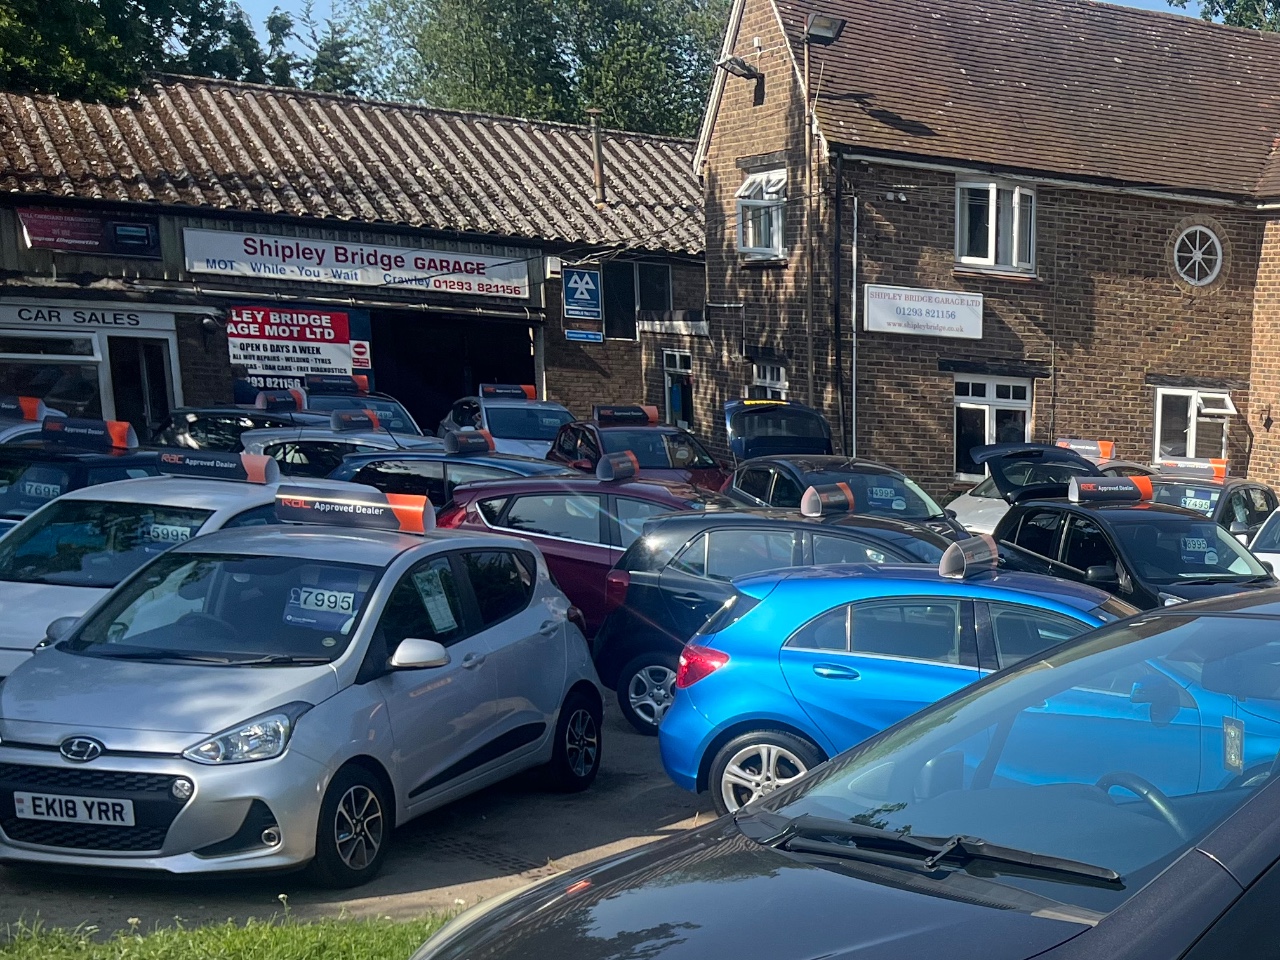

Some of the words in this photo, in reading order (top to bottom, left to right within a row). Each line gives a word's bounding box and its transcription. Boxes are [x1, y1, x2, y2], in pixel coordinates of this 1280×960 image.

[243, 237, 326, 265] Shipley
[334, 246, 405, 272] Bridge
[414, 257, 486, 275] GARAGE
[206, 258, 236, 271] MOT
[250, 262, 286, 275] While
[297, 266, 320, 278] You
[331, 268, 359, 281] Wait
[383, 273, 431, 288] Crawley
[434, 279, 472, 292] 01293
[477, 283, 521, 295] 821156
[870, 291, 902, 301] SHIPLEY
[904, 294, 933, 303] BRIDGE
[934, 297, 966, 306] GARAGE
[966, 299, 980, 307] LTD
[18, 308, 61, 322] CAR
[73, 311, 140, 326] SALES
[269, 312, 332, 327] BRIDGE
[895, 306, 923, 317] 01293
[924, 309, 956, 319] 821156
[265, 325, 300, 338] MOT
[306, 327, 335, 340] LTD
[886, 321, 964, 332] www.shipleybridge.co.uk
[239, 342, 261, 352] OPEN
[270, 345, 290, 353] DAYS
[299, 346, 321, 355] WEEK
[185, 458, 215, 467] Approved
[215, 459, 237, 469] Dealer
[26, 482, 60, 498] 7695
[314, 501, 354, 513] Approved
[355, 505, 385, 516] Dealer
[151, 526, 190, 542] 5995
[31, 796, 78, 818] EK18
[83, 800, 126, 822] YRR
